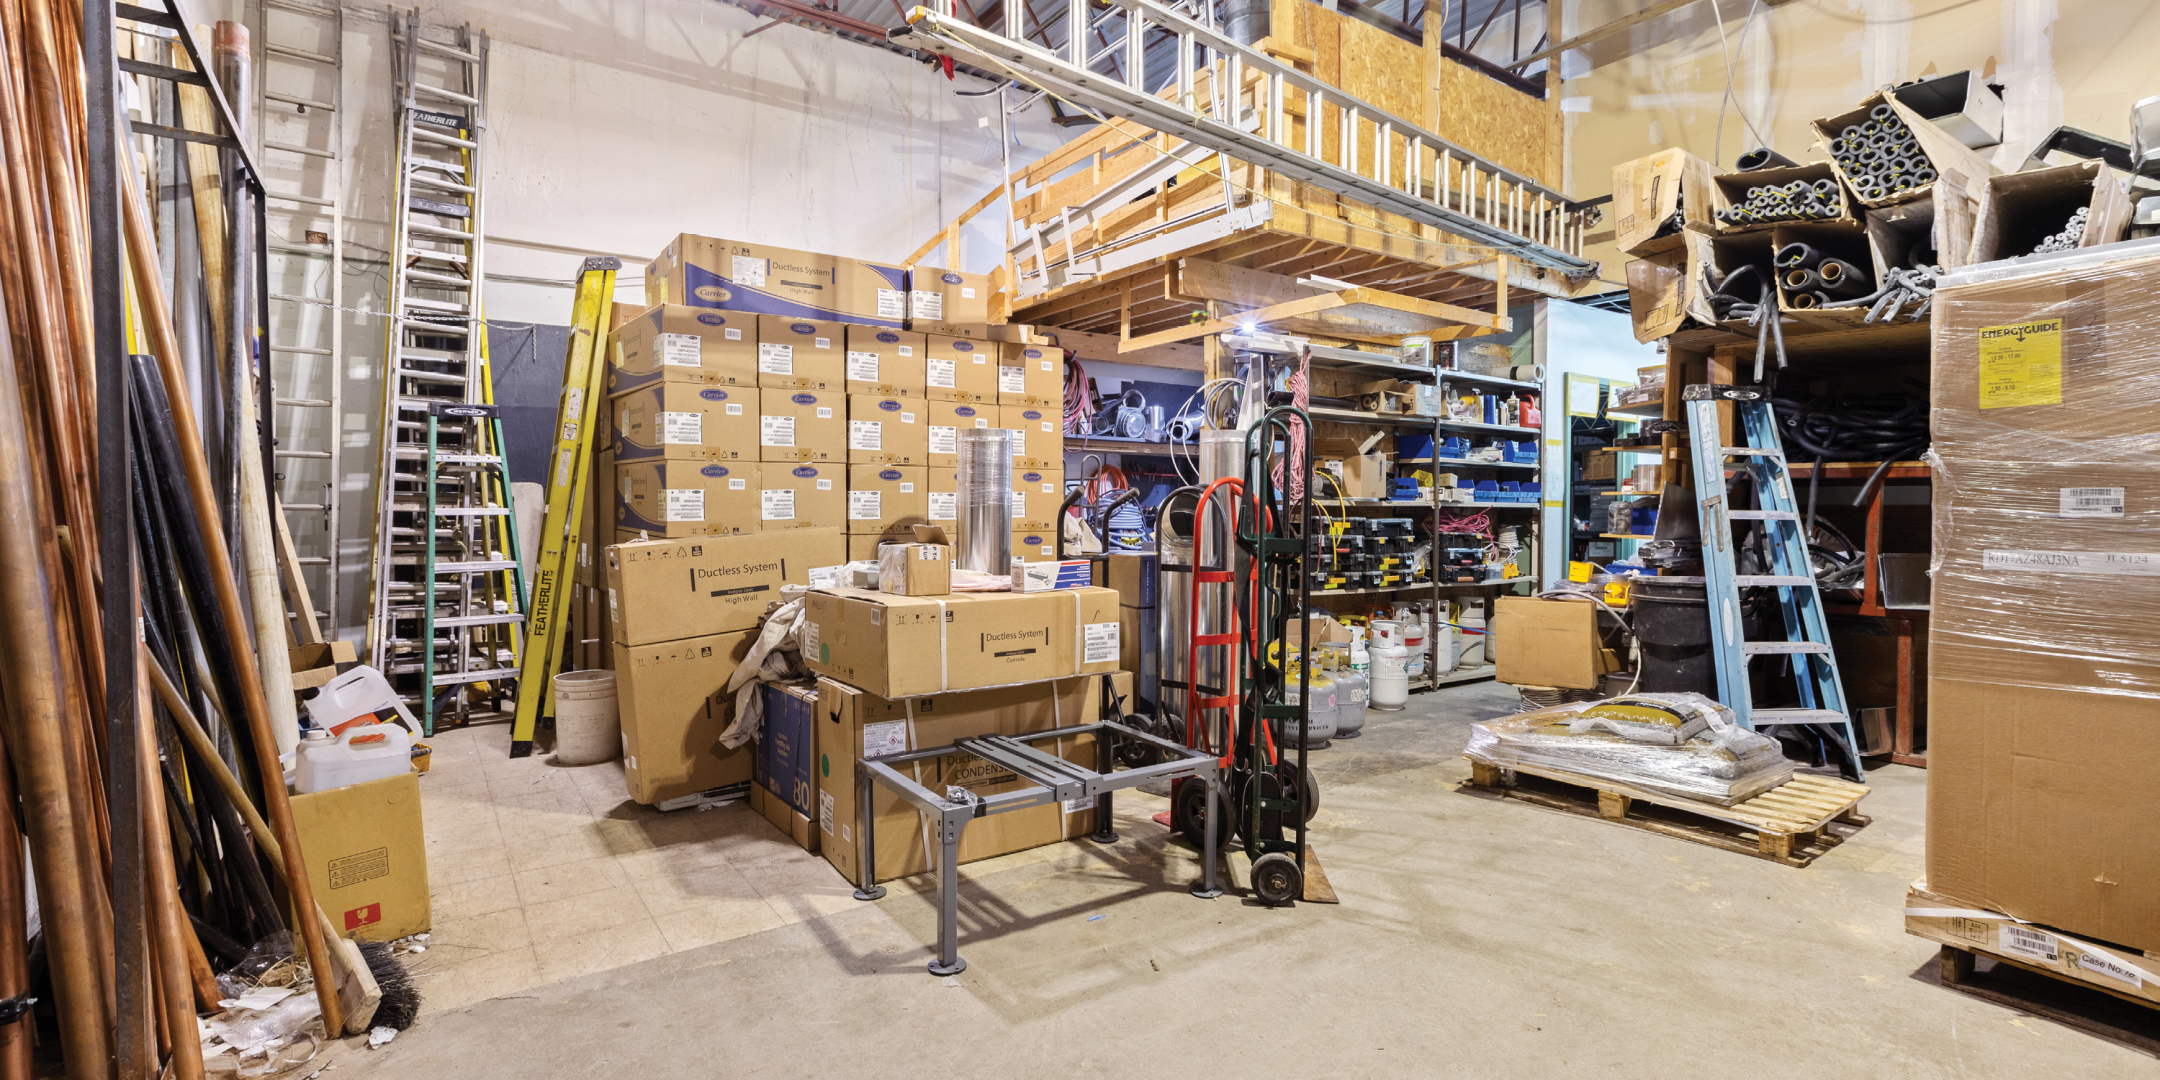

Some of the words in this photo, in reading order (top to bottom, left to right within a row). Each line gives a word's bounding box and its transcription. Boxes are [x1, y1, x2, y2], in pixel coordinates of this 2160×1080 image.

[772, 262, 803, 274] Ductless
[804, 266, 830, 277] System
[700, 288, 728, 299] Carrier
[790, 287, 804, 295] High
[1982, 322, 2059, 339] ENERGYGUIDE
[698, 565, 741, 578] Ductless
[742, 562, 778, 575] System
[534, 569, 554, 636] FEATHERLITE
[724, 595, 742, 605] High
[742, 594, 758, 602] Wall
[986, 632, 1017, 642] Ductless
[1018, 630, 1044, 640] System
[1006, 656, 1026, 664] Console
[948, 753, 984, 766] Ductles
[954, 764, 1010, 780] CONDENS
[793, 776, 810, 811] 80
[2082, 954, 2106, 968] Case
